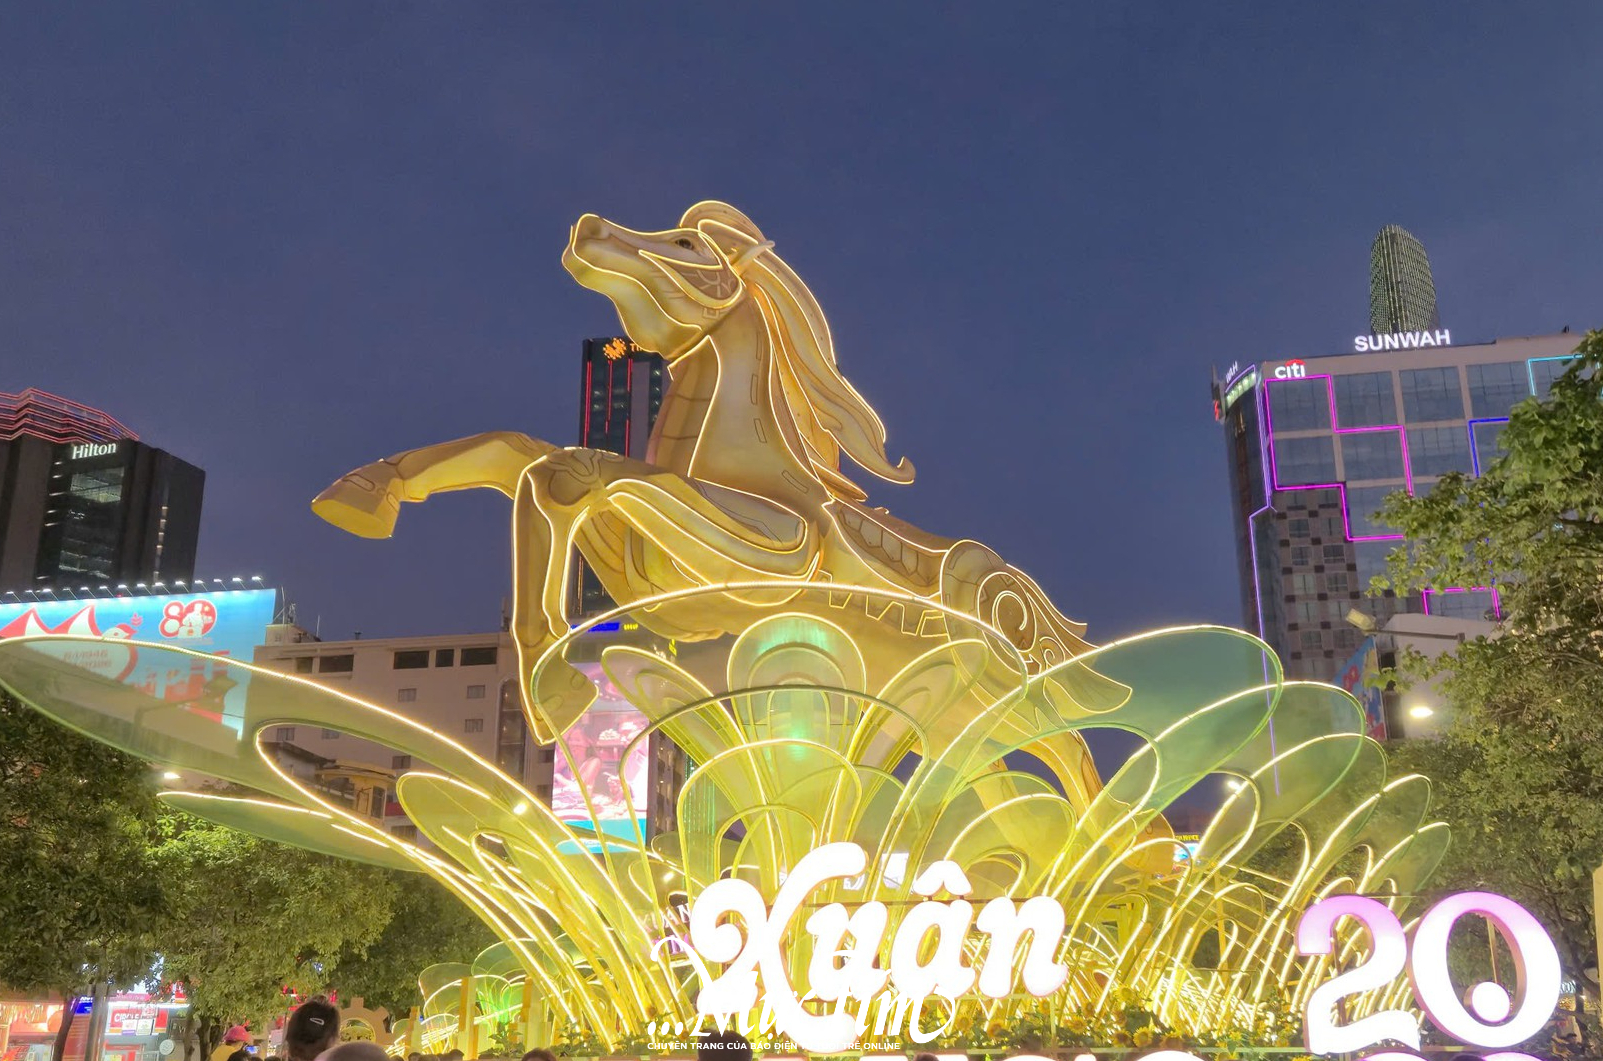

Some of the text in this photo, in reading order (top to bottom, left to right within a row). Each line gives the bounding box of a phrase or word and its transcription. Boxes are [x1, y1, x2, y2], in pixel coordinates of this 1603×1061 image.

[1354, 329, 1451, 352] SUNWAH
[1274, 360, 1306, 378] citi
[72, 443, 117, 459] Hilton
[690, 841, 1562, 1055] Xuân 20
